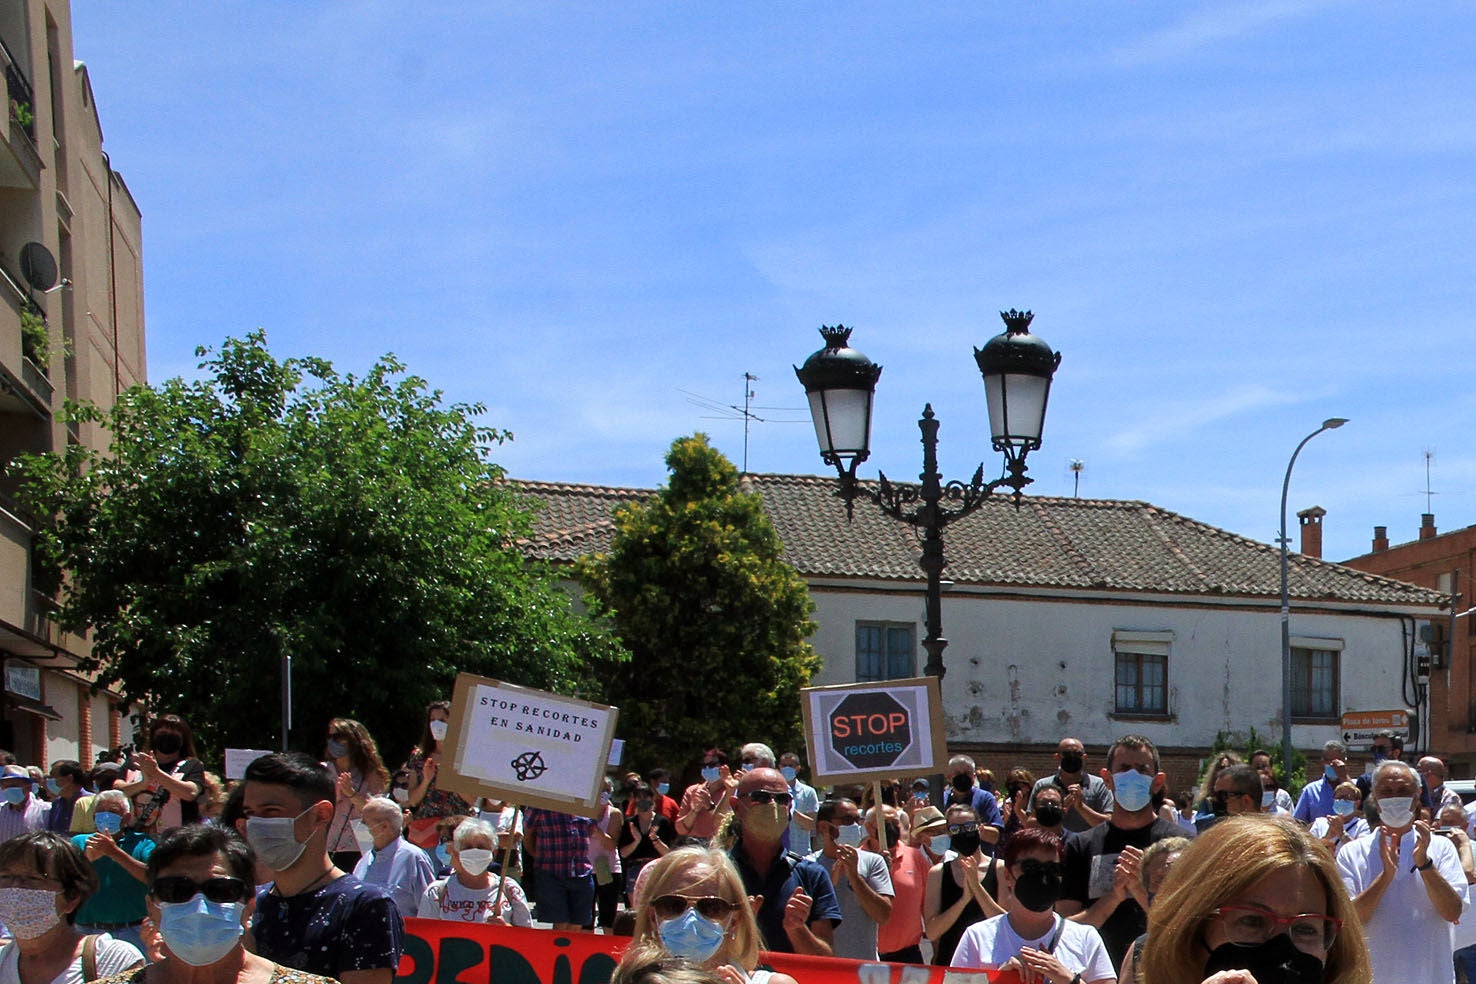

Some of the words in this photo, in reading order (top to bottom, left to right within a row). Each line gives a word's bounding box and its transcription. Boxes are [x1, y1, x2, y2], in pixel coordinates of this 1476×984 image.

[480, 696, 518, 711] STOP
[522, 705, 598, 729] RECORTES
[833, 712, 906, 738] STOP
[490, 716, 509, 728] EN
[515, 721, 582, 743] SANIDAD
[844, 741, 903, 756] recortes
